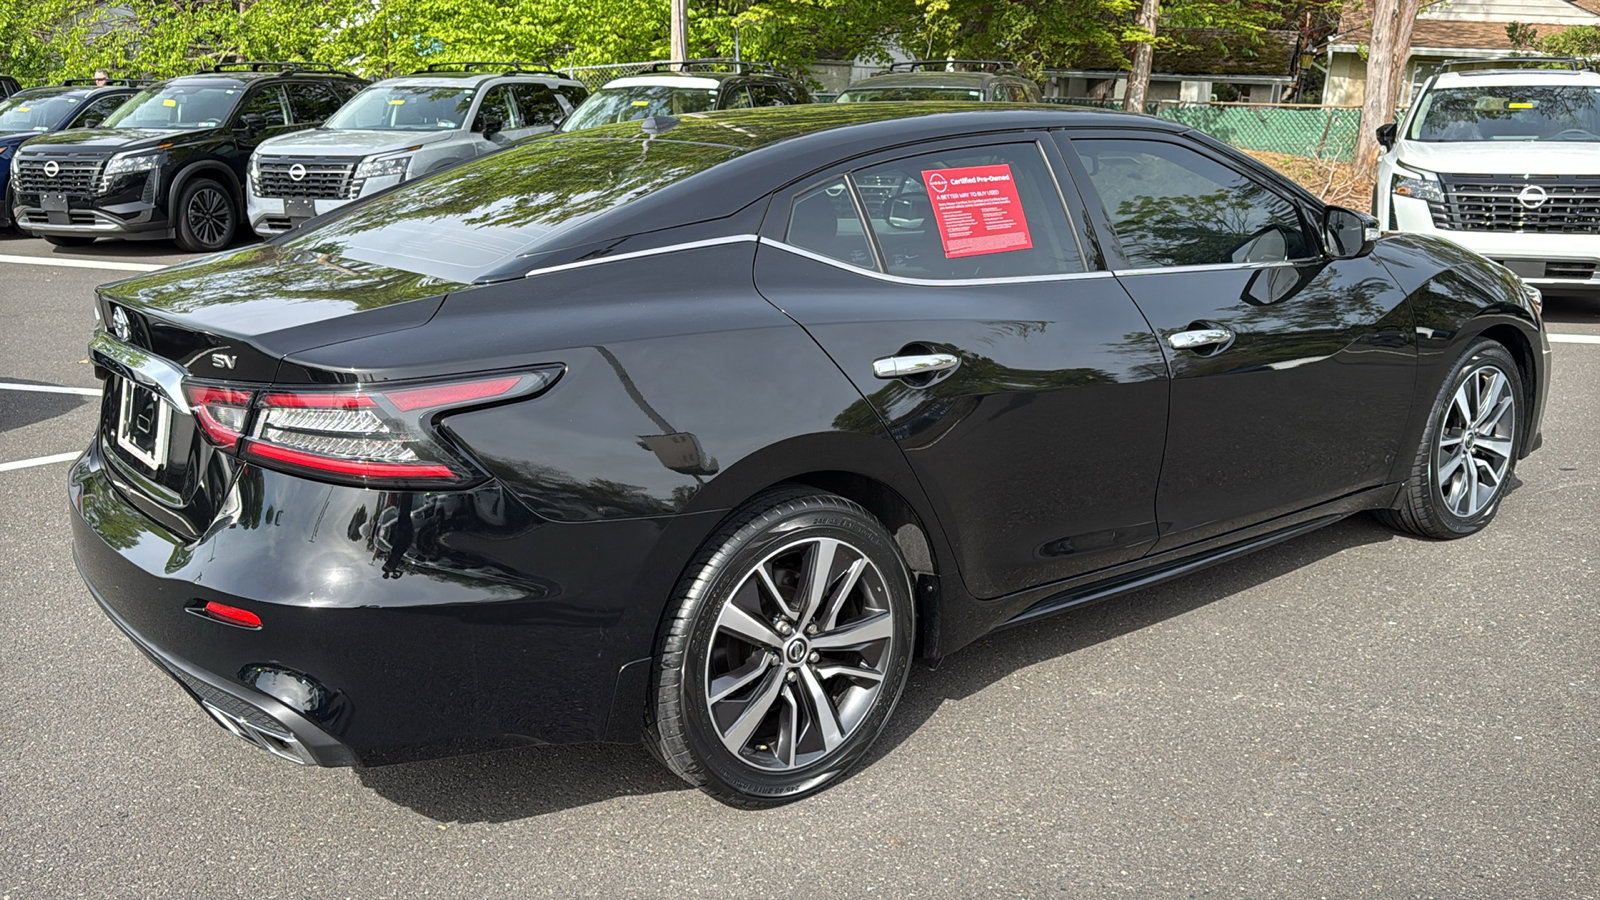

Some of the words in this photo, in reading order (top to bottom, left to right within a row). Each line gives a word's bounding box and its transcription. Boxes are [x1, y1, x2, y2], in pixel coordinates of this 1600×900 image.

[950, 177, 976, 185] Certified
[977, 174, 1010, 182] Pre-Owned
[212, 354, 237, 369] SV
